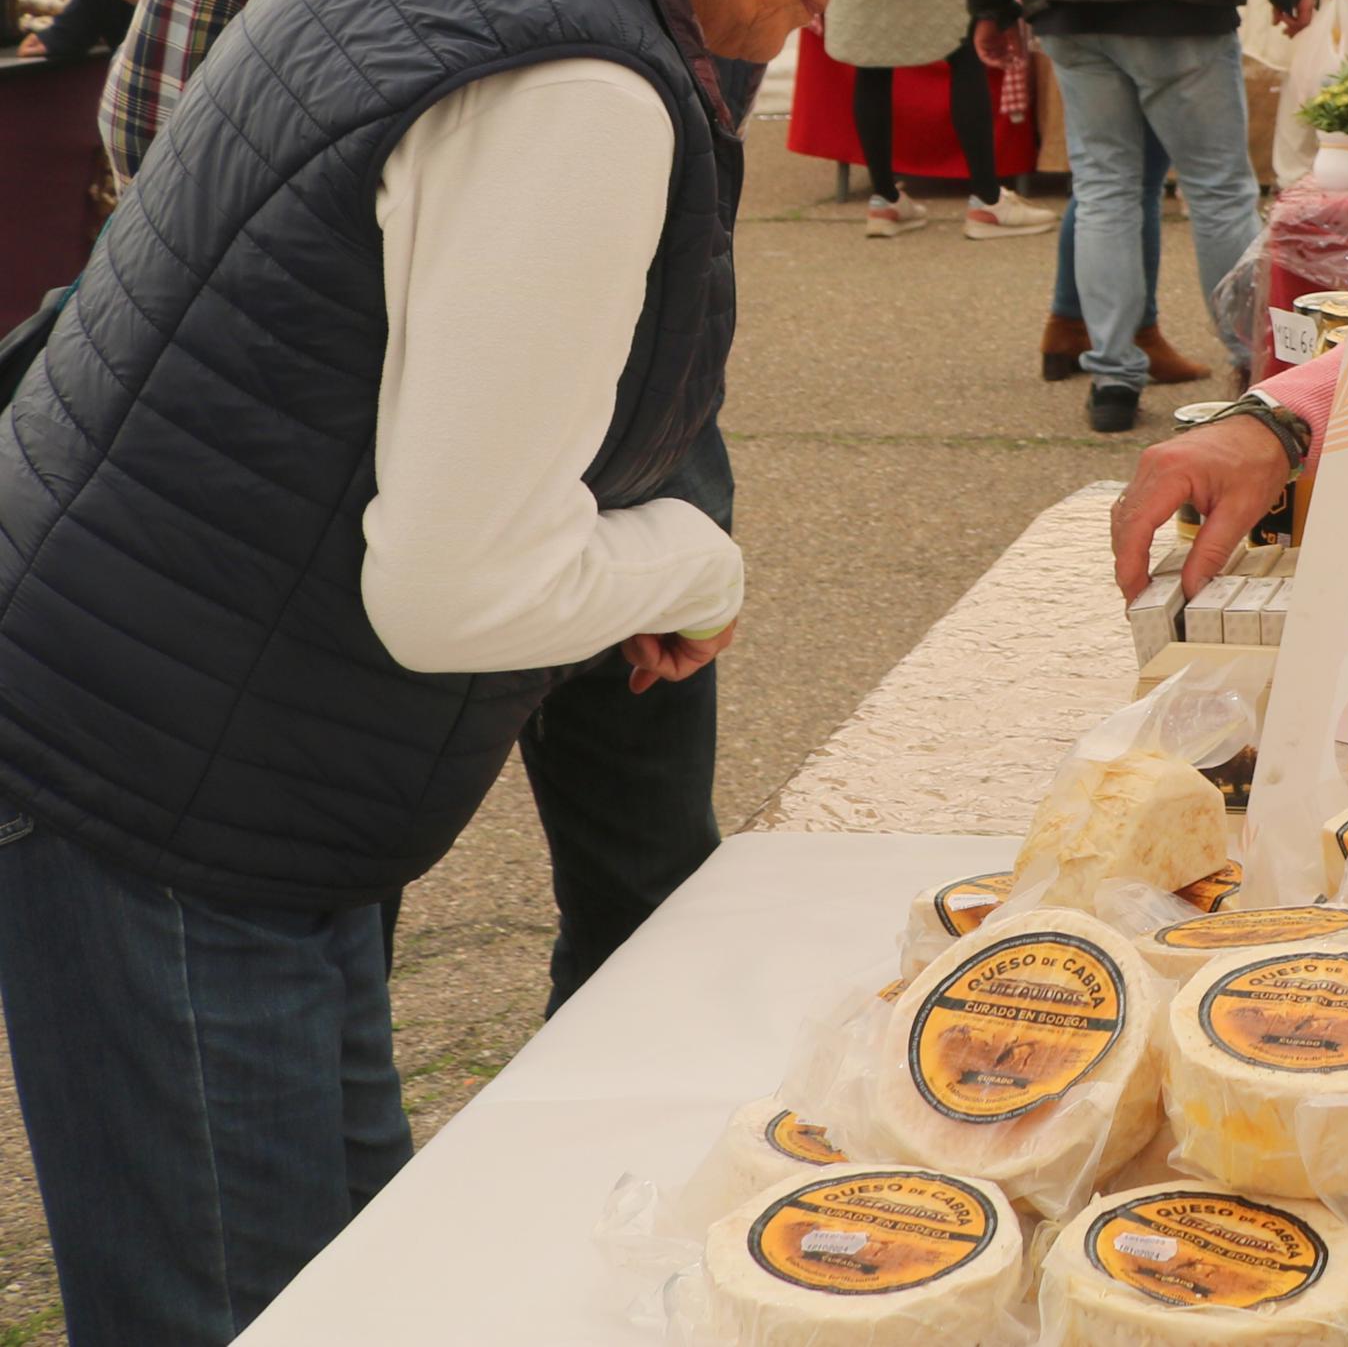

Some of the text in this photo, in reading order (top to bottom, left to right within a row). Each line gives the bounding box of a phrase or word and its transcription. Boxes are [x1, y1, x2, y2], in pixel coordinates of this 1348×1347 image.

[967, 953, 1107, 1010] QUESO DE CABRA
[1249, 964, 1319, 987] QUESO
[1325, 966, 1343, 974] DE
[964, 1002, 1089, 1030] CURADO EN BODEGA
[1250, 991, 1308, 1003] CURADO
[1309, 996, 1329, 1007] EN
[818, 1206, 952, 1240] CURADO EN BODEGA
[823, 1182, 975, 1229] QUESO DE CABRA
[1150, 1220, 1206, 1248] CURADO
[1206, 1240, 1228, 1255] EN
[1226, 1249, 1282, 1271] BODEGA
[1156, 1203, 1303, 1261] QUESO DE CABRA
